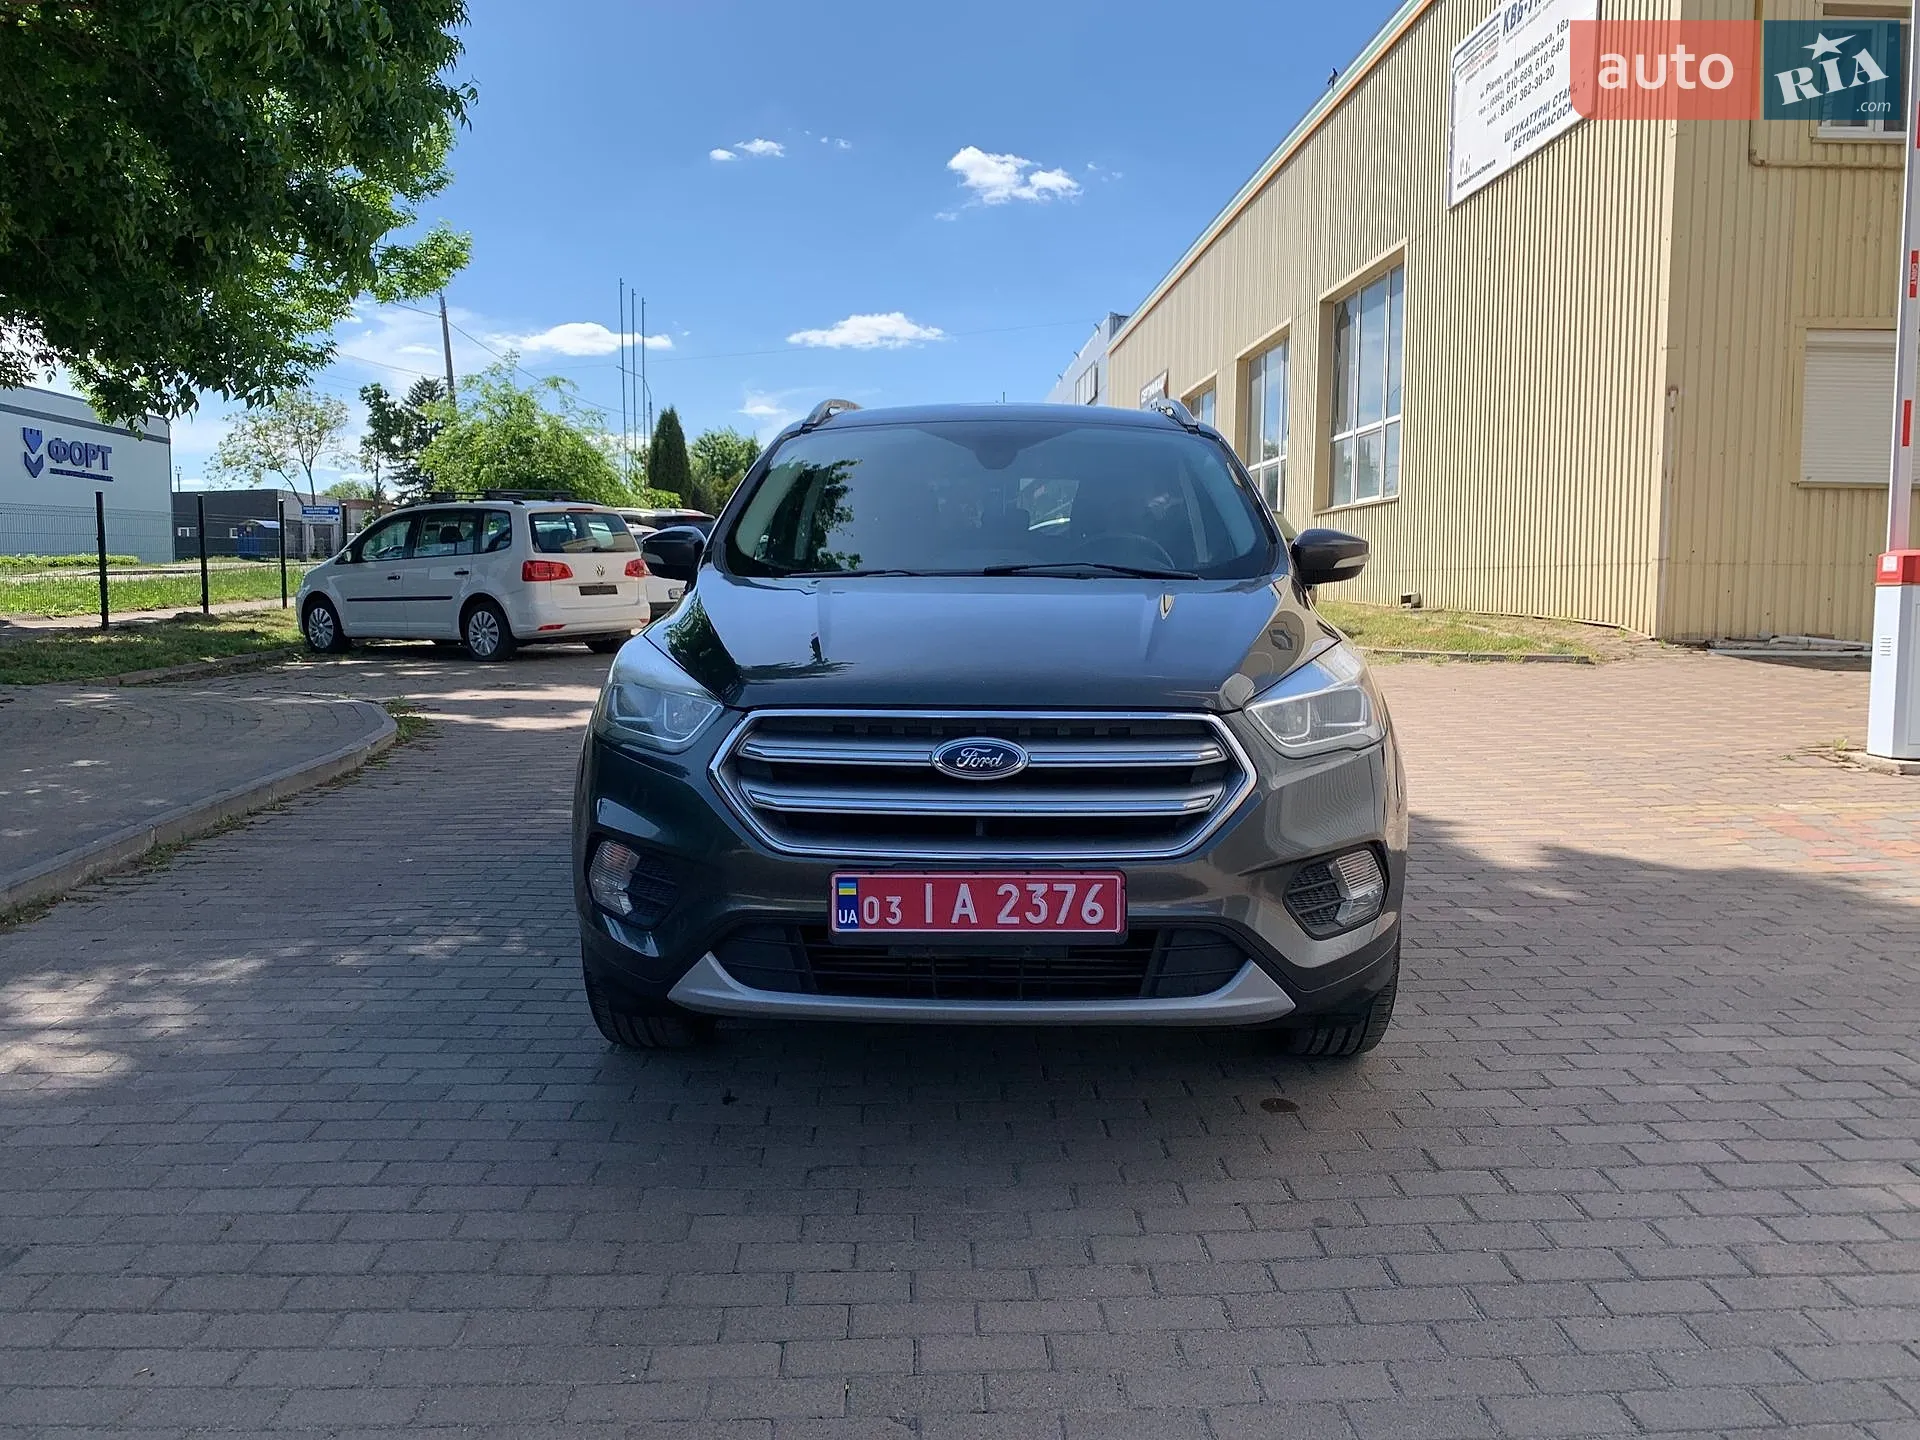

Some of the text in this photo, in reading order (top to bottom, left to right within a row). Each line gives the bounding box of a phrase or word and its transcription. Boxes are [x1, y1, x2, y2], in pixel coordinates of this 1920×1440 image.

[1519, 64, 1555, 101] 362-30-20
[1504, 100, 1551, 143] ШТУКАТУРНІ
[47, 437, 113, 471] ФОРТ
[956, 747, 1004, 768] Ford
[838, 909, 858, 924] UA
[862, 895, 902, 925] 03
[996, 883, 1104, 925] 2376
